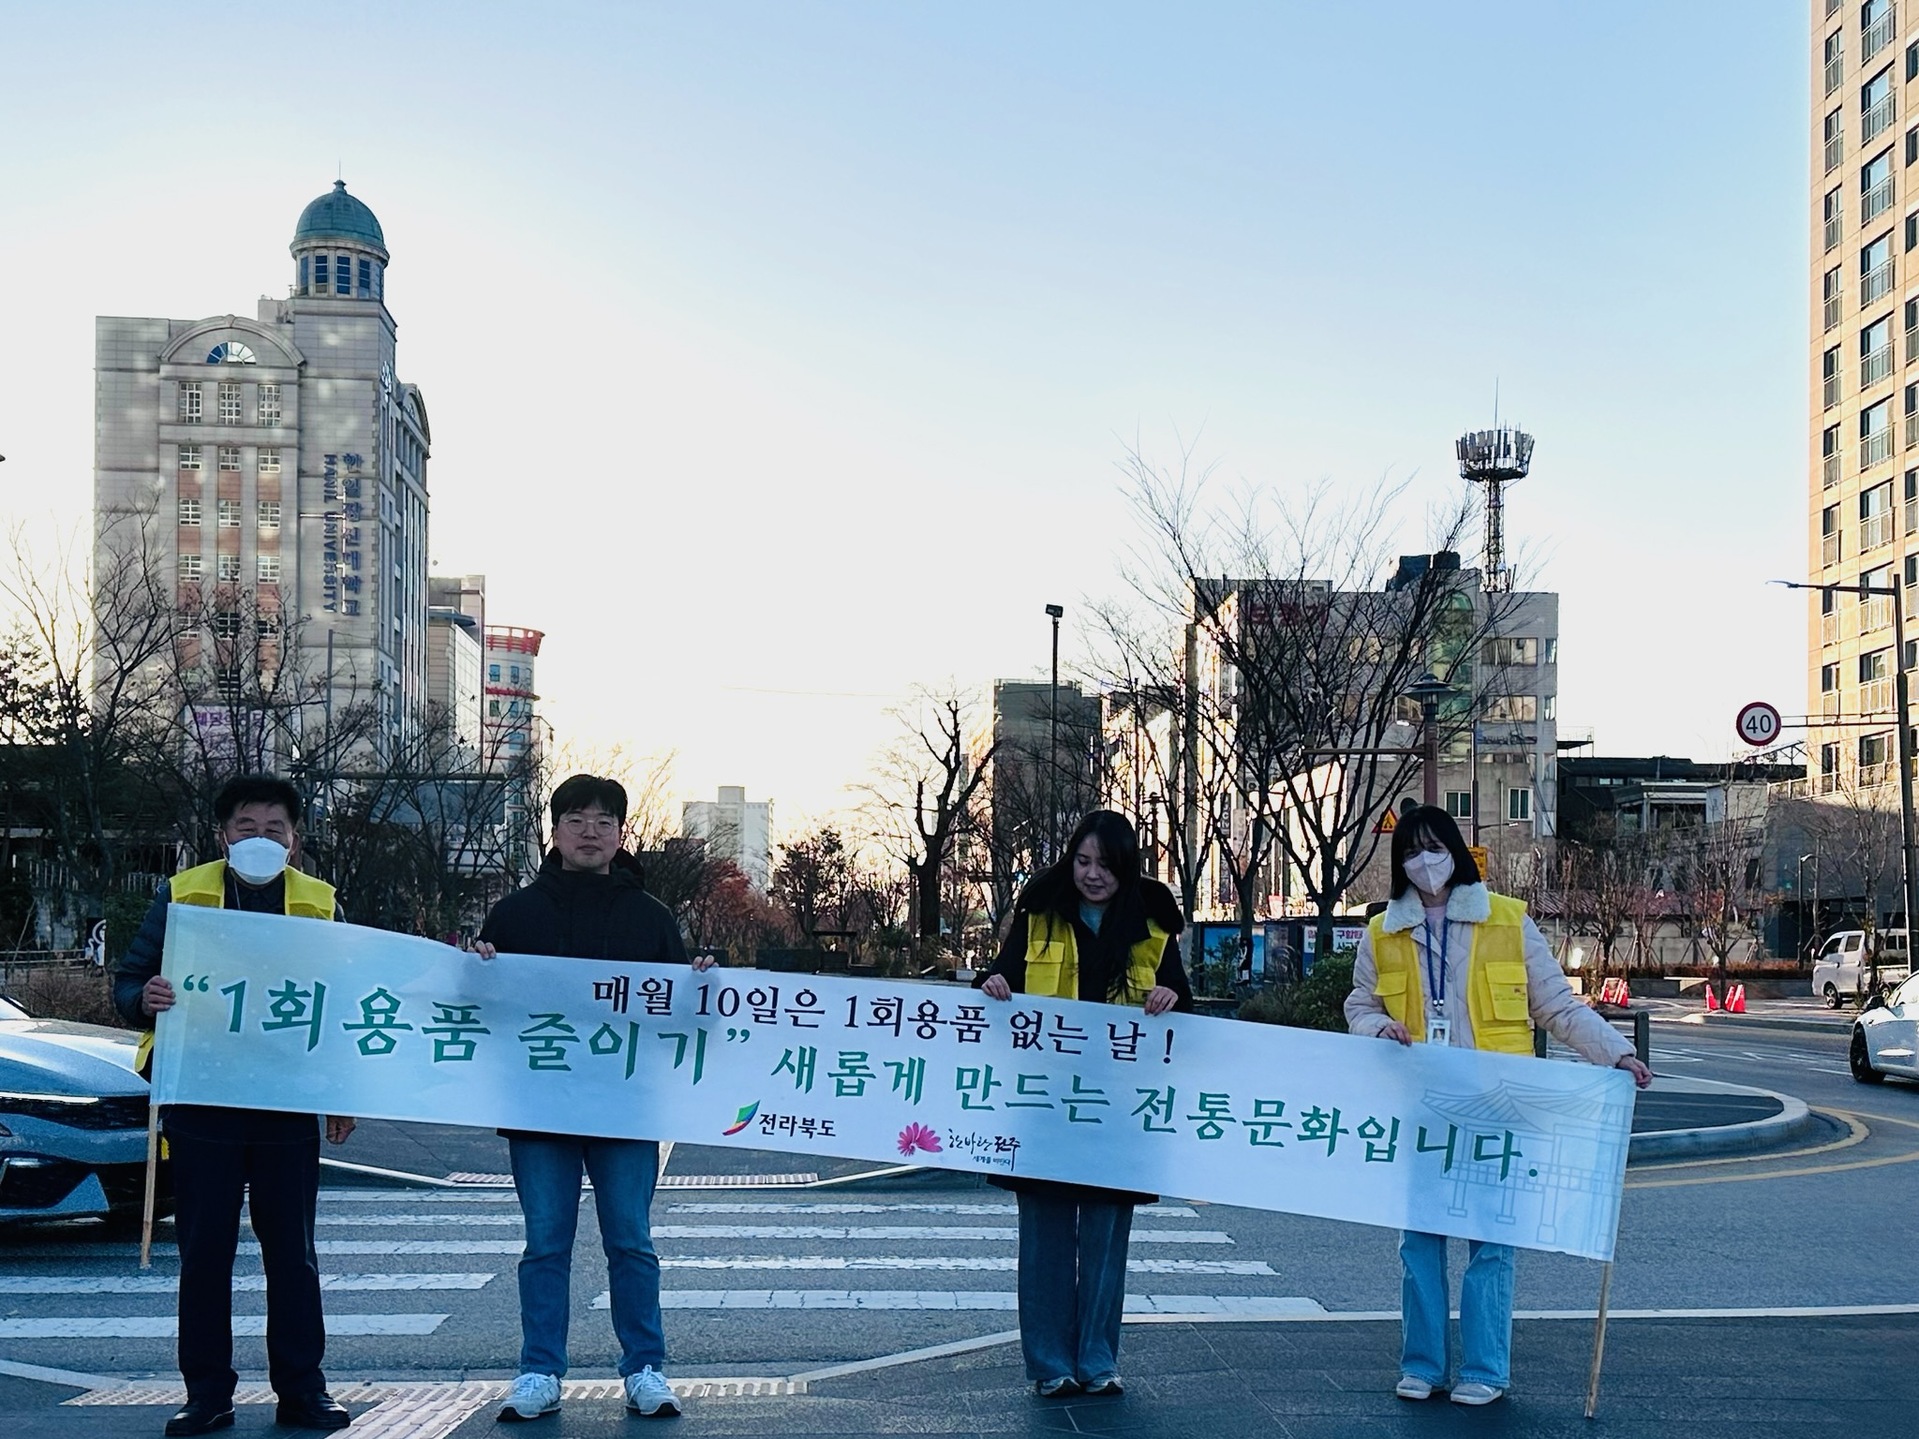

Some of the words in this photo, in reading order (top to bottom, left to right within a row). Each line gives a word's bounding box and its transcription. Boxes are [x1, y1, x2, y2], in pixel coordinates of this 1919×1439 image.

[323, 454, 338, 503] HANIL
[323, 511, 338, 613] UNIVERSITY
[1745, 714, 1772, 734] 40
[592, 975, 674, 1017] 매월
[694, 984, 826, 1029] 10일은
[844, 996, 991, 1044] 1회용품
[1009, 1010, 1089, 1056] 없는
[759, 1113, 837, 1140] 전라북도
[770, 1045, 927, 1106] 새롭게
[955, 1063, 1112, 1125] 만드는
[1130, 1085, 1540, 1183] 전통문화입니다.
